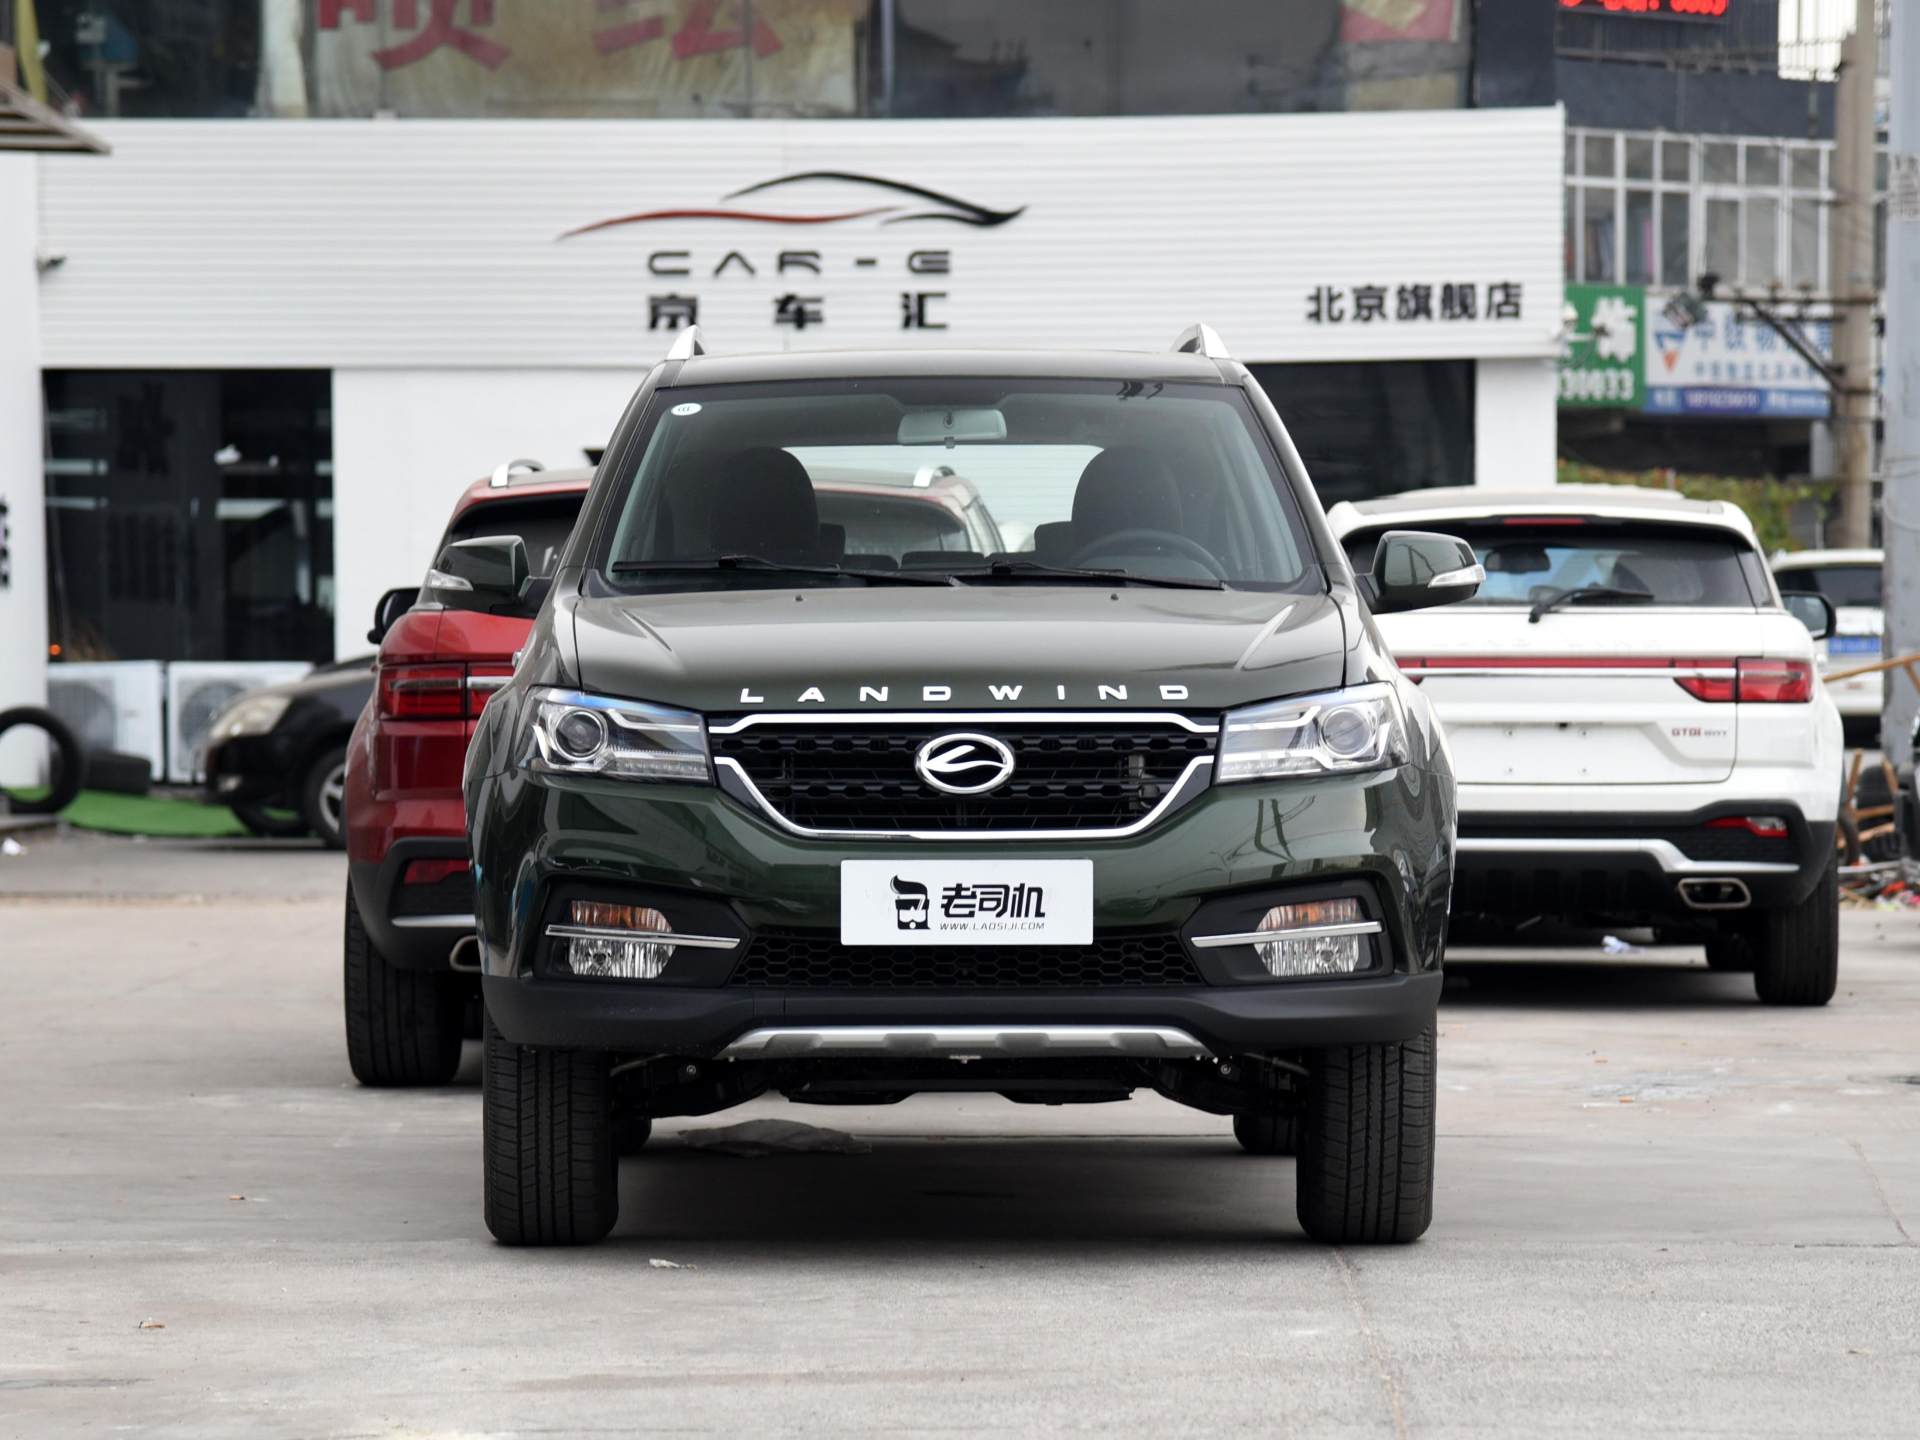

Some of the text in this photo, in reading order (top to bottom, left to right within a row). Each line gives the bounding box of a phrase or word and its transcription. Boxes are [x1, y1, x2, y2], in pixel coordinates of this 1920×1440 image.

[647, 250, 951, 276] CAR-E
[1306, 281, 1522, 323] 北京旗舰店
[740, 685, 1189, 703] LANDWIND
[940, 882, 1046, 918] 老司机
[940, 921, 1045, 931] WWW.LAOSIJI.COM
